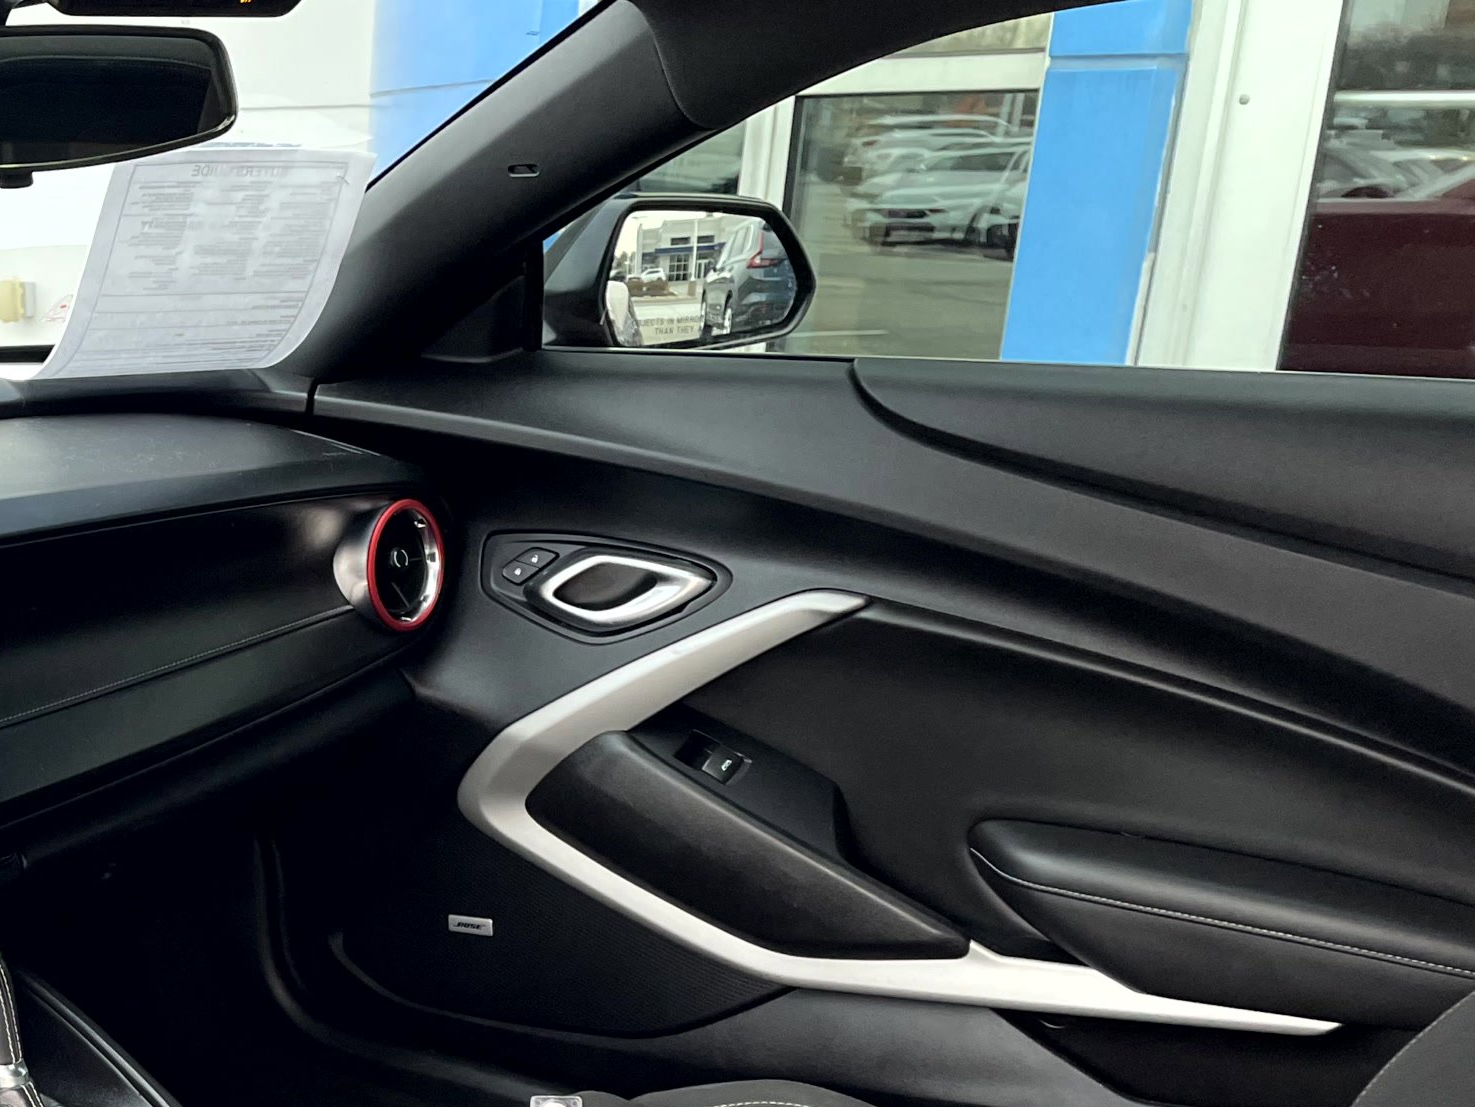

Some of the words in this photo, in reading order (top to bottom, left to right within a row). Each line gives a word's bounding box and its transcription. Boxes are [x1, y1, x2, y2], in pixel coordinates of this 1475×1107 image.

[676, 315, 702, 324] MIRRO
[655, 326, 674, 335] THAN
[677, 325, 694, 334] THEY
